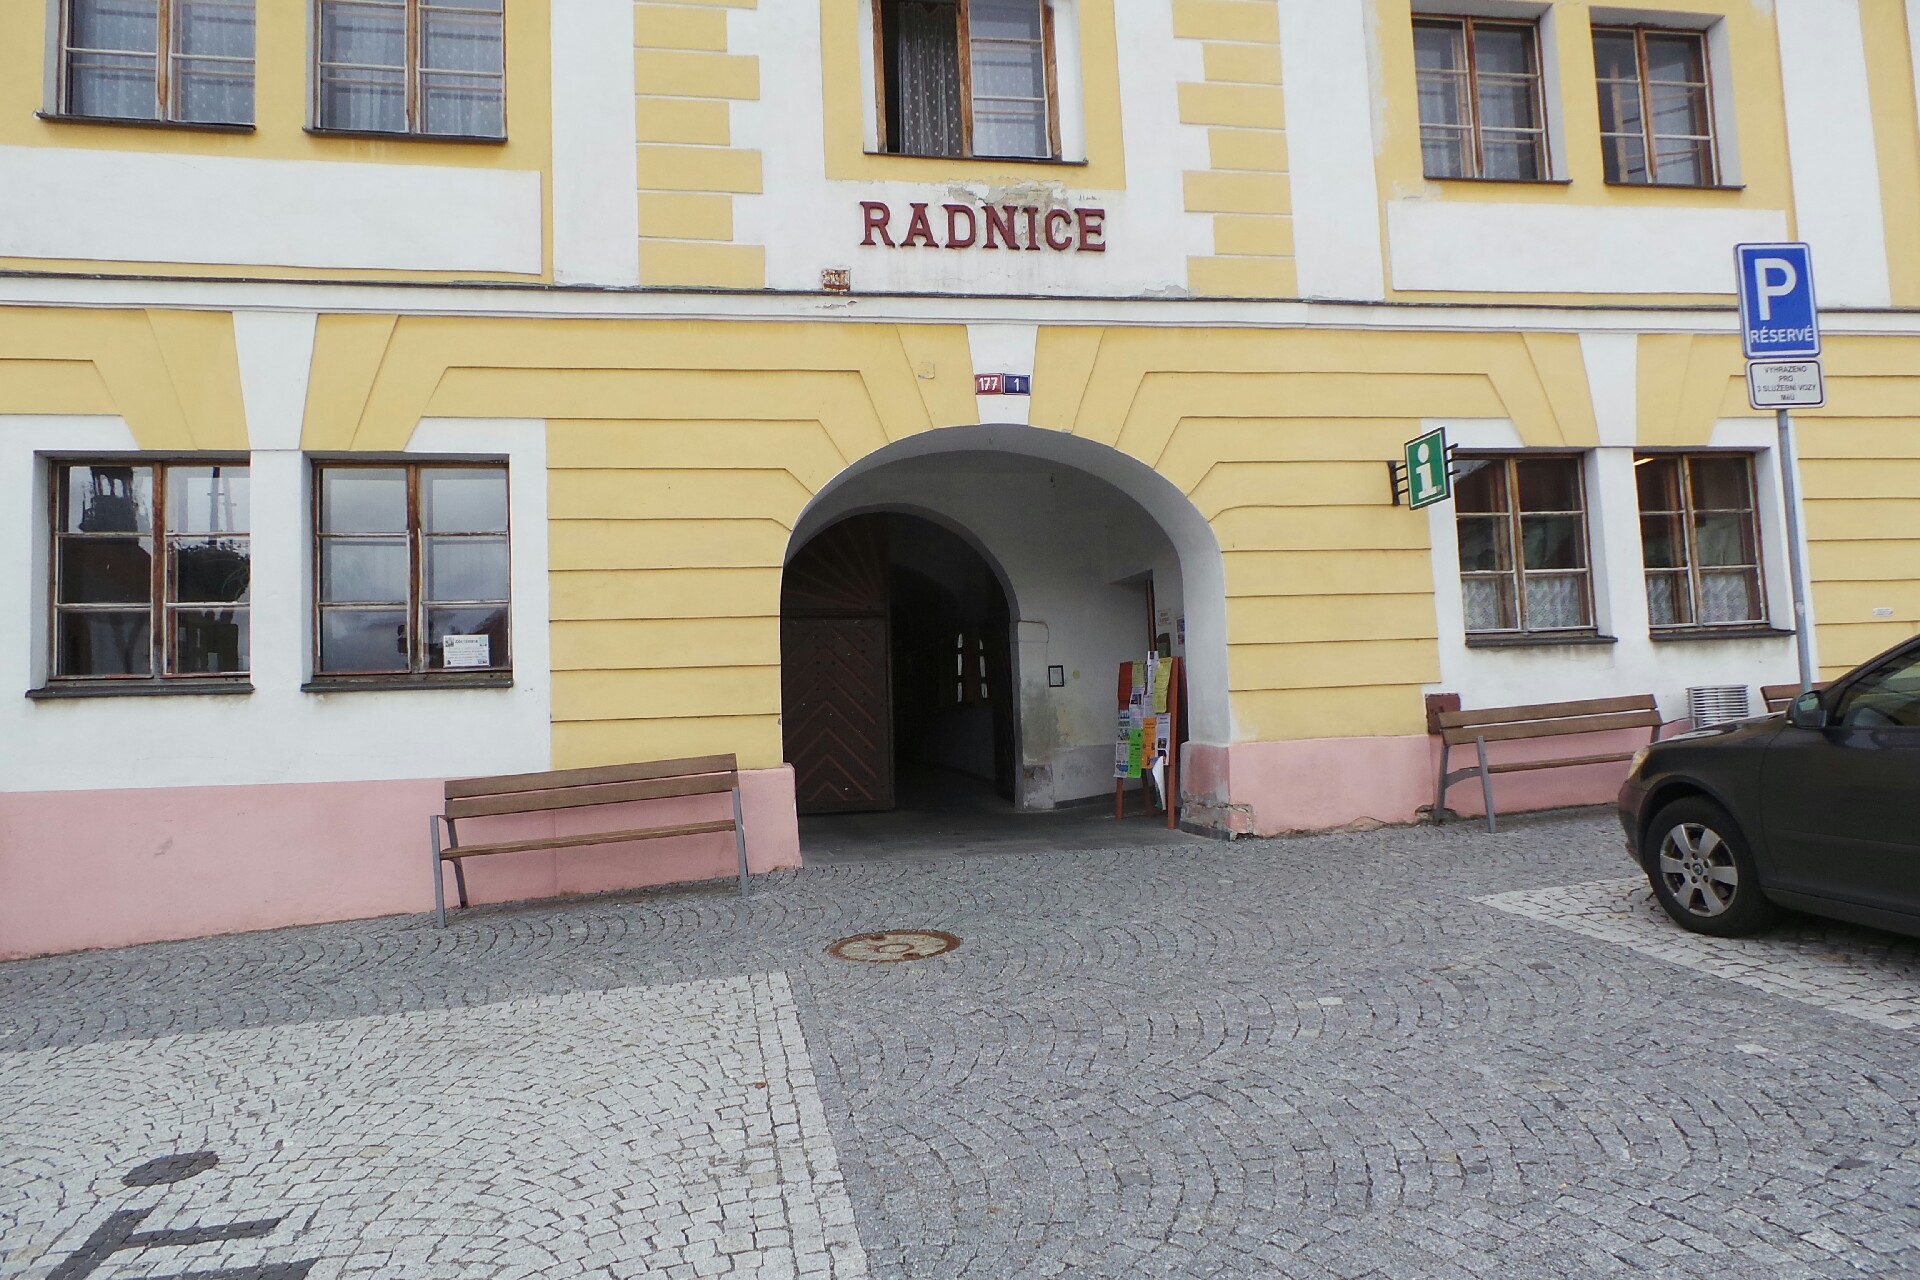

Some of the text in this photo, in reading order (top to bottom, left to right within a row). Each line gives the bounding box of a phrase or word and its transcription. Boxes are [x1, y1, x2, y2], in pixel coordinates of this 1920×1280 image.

[859, 201, 1106, 251] RADNICE
[1754, 257, 1797, 321] P
[1750, 324, 1814, 343] RÉSERVÉ
[1764, 365, 1807, 373] VYHRAZENO
[978, 377, 998, 391] 177
[1013, 377, 1020, 392] 1
[1763, 383, 1797, 392] SLUŽEBNÍ
